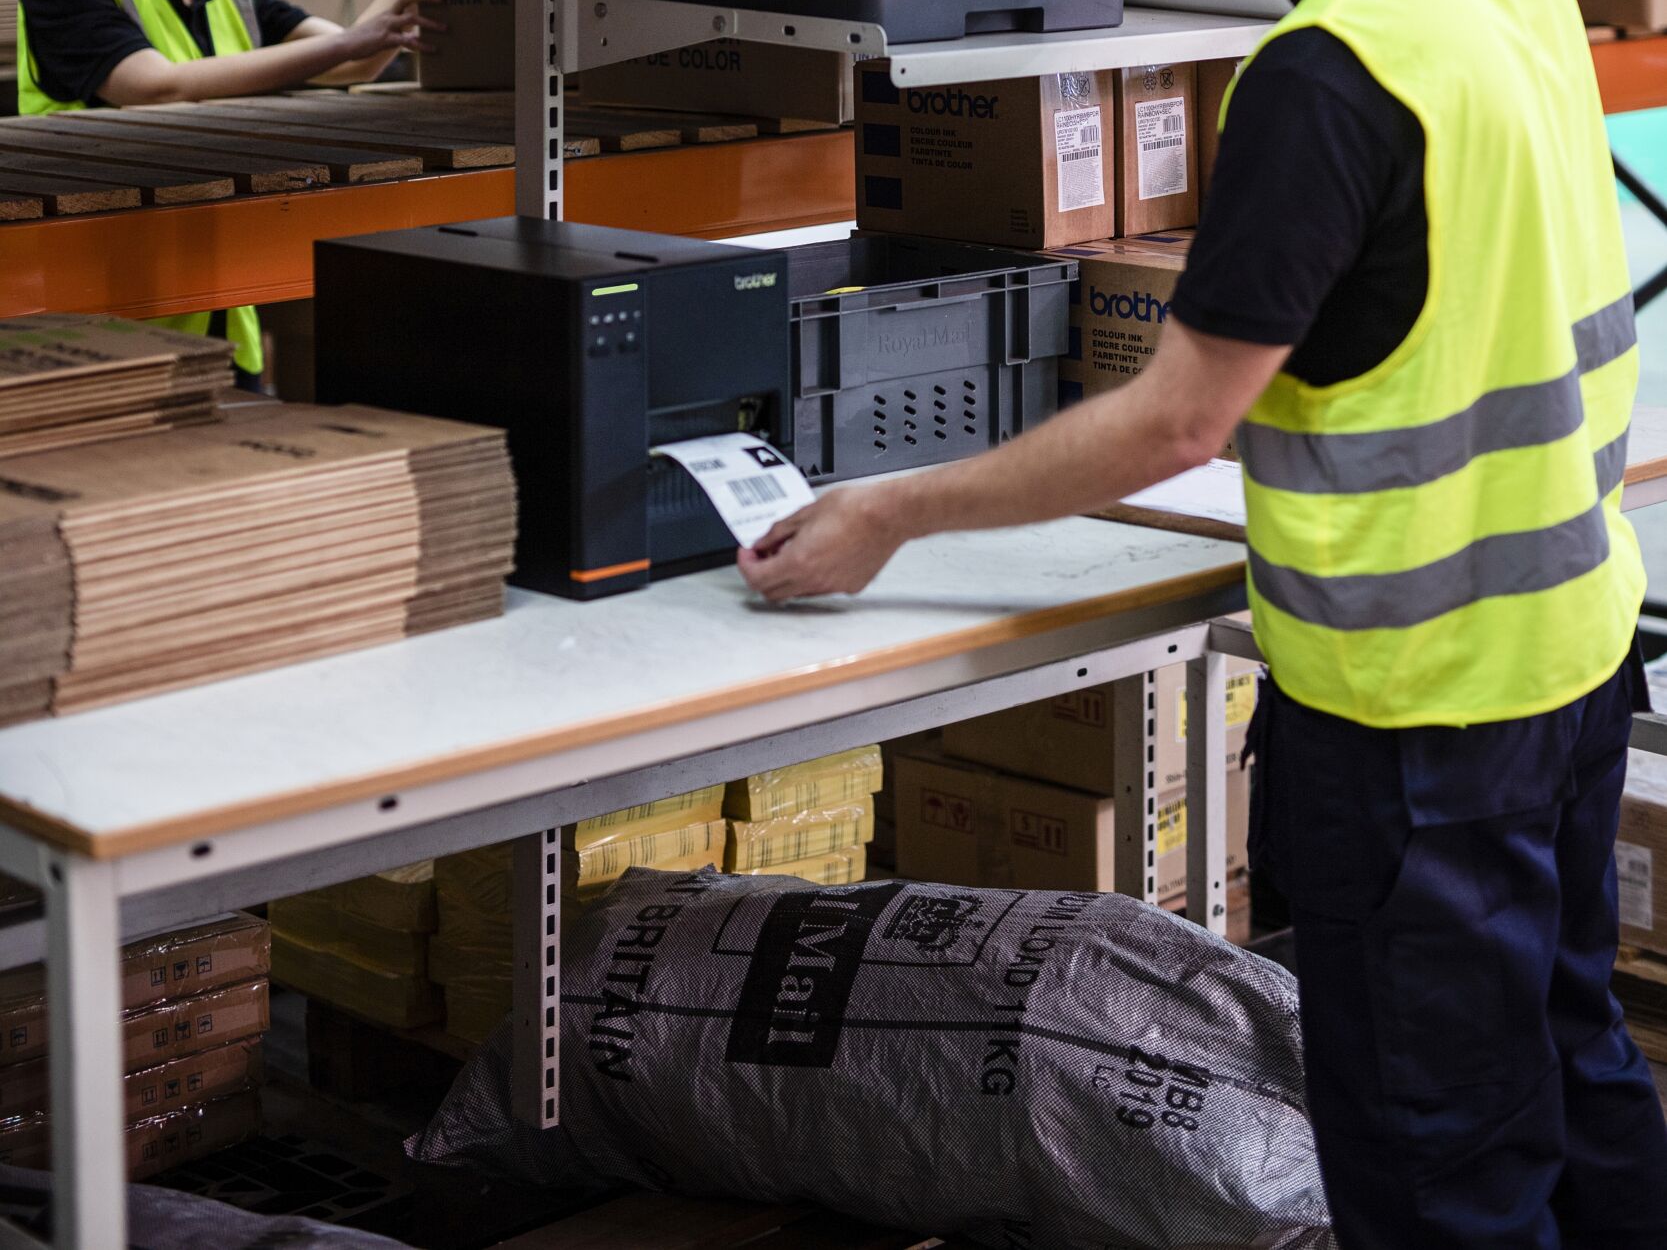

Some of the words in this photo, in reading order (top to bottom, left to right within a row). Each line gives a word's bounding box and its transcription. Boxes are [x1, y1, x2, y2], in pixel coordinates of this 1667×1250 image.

[679, 50, 741, 71] COLOR
[907, 86, 999, 119] brother
[910, 127, 941, 136] COLOUR
[942, 128, 956, 137] INK
[910, 137, 936, 146] ENCRE
[937, 139, 973, 149] COULEUR
[910, 147, 953, 158] FARBTINTE
[911, 158, 934, 167] TINTA
[935, 159, 945, 168] DE
[947, 161, 973, 170] COLOR
[734, 272, 778, 291] brother
[1089, 285, 1168, 324] broth
[878, 329, 928, 357] Royal
[932, 324, 971, 347] Mail
[1092, 329, 1126, 341] COLOUR
[1128, 333, 1143, 342] INK
[1092, 340, 1120, 351] ENCRE
[1121, 343, 1156, 356] COULEU
[1092, 351, 1138, 364] FARBTINTE
[1093, 361, 1117, 373] TINTA
[1119, 365, 1131, 374] DE
[1004, 924, 1066, 989] LOAD
[767, 919, 849, 1046] Mail
[587, 903, 685, 1083] BRITAIN
